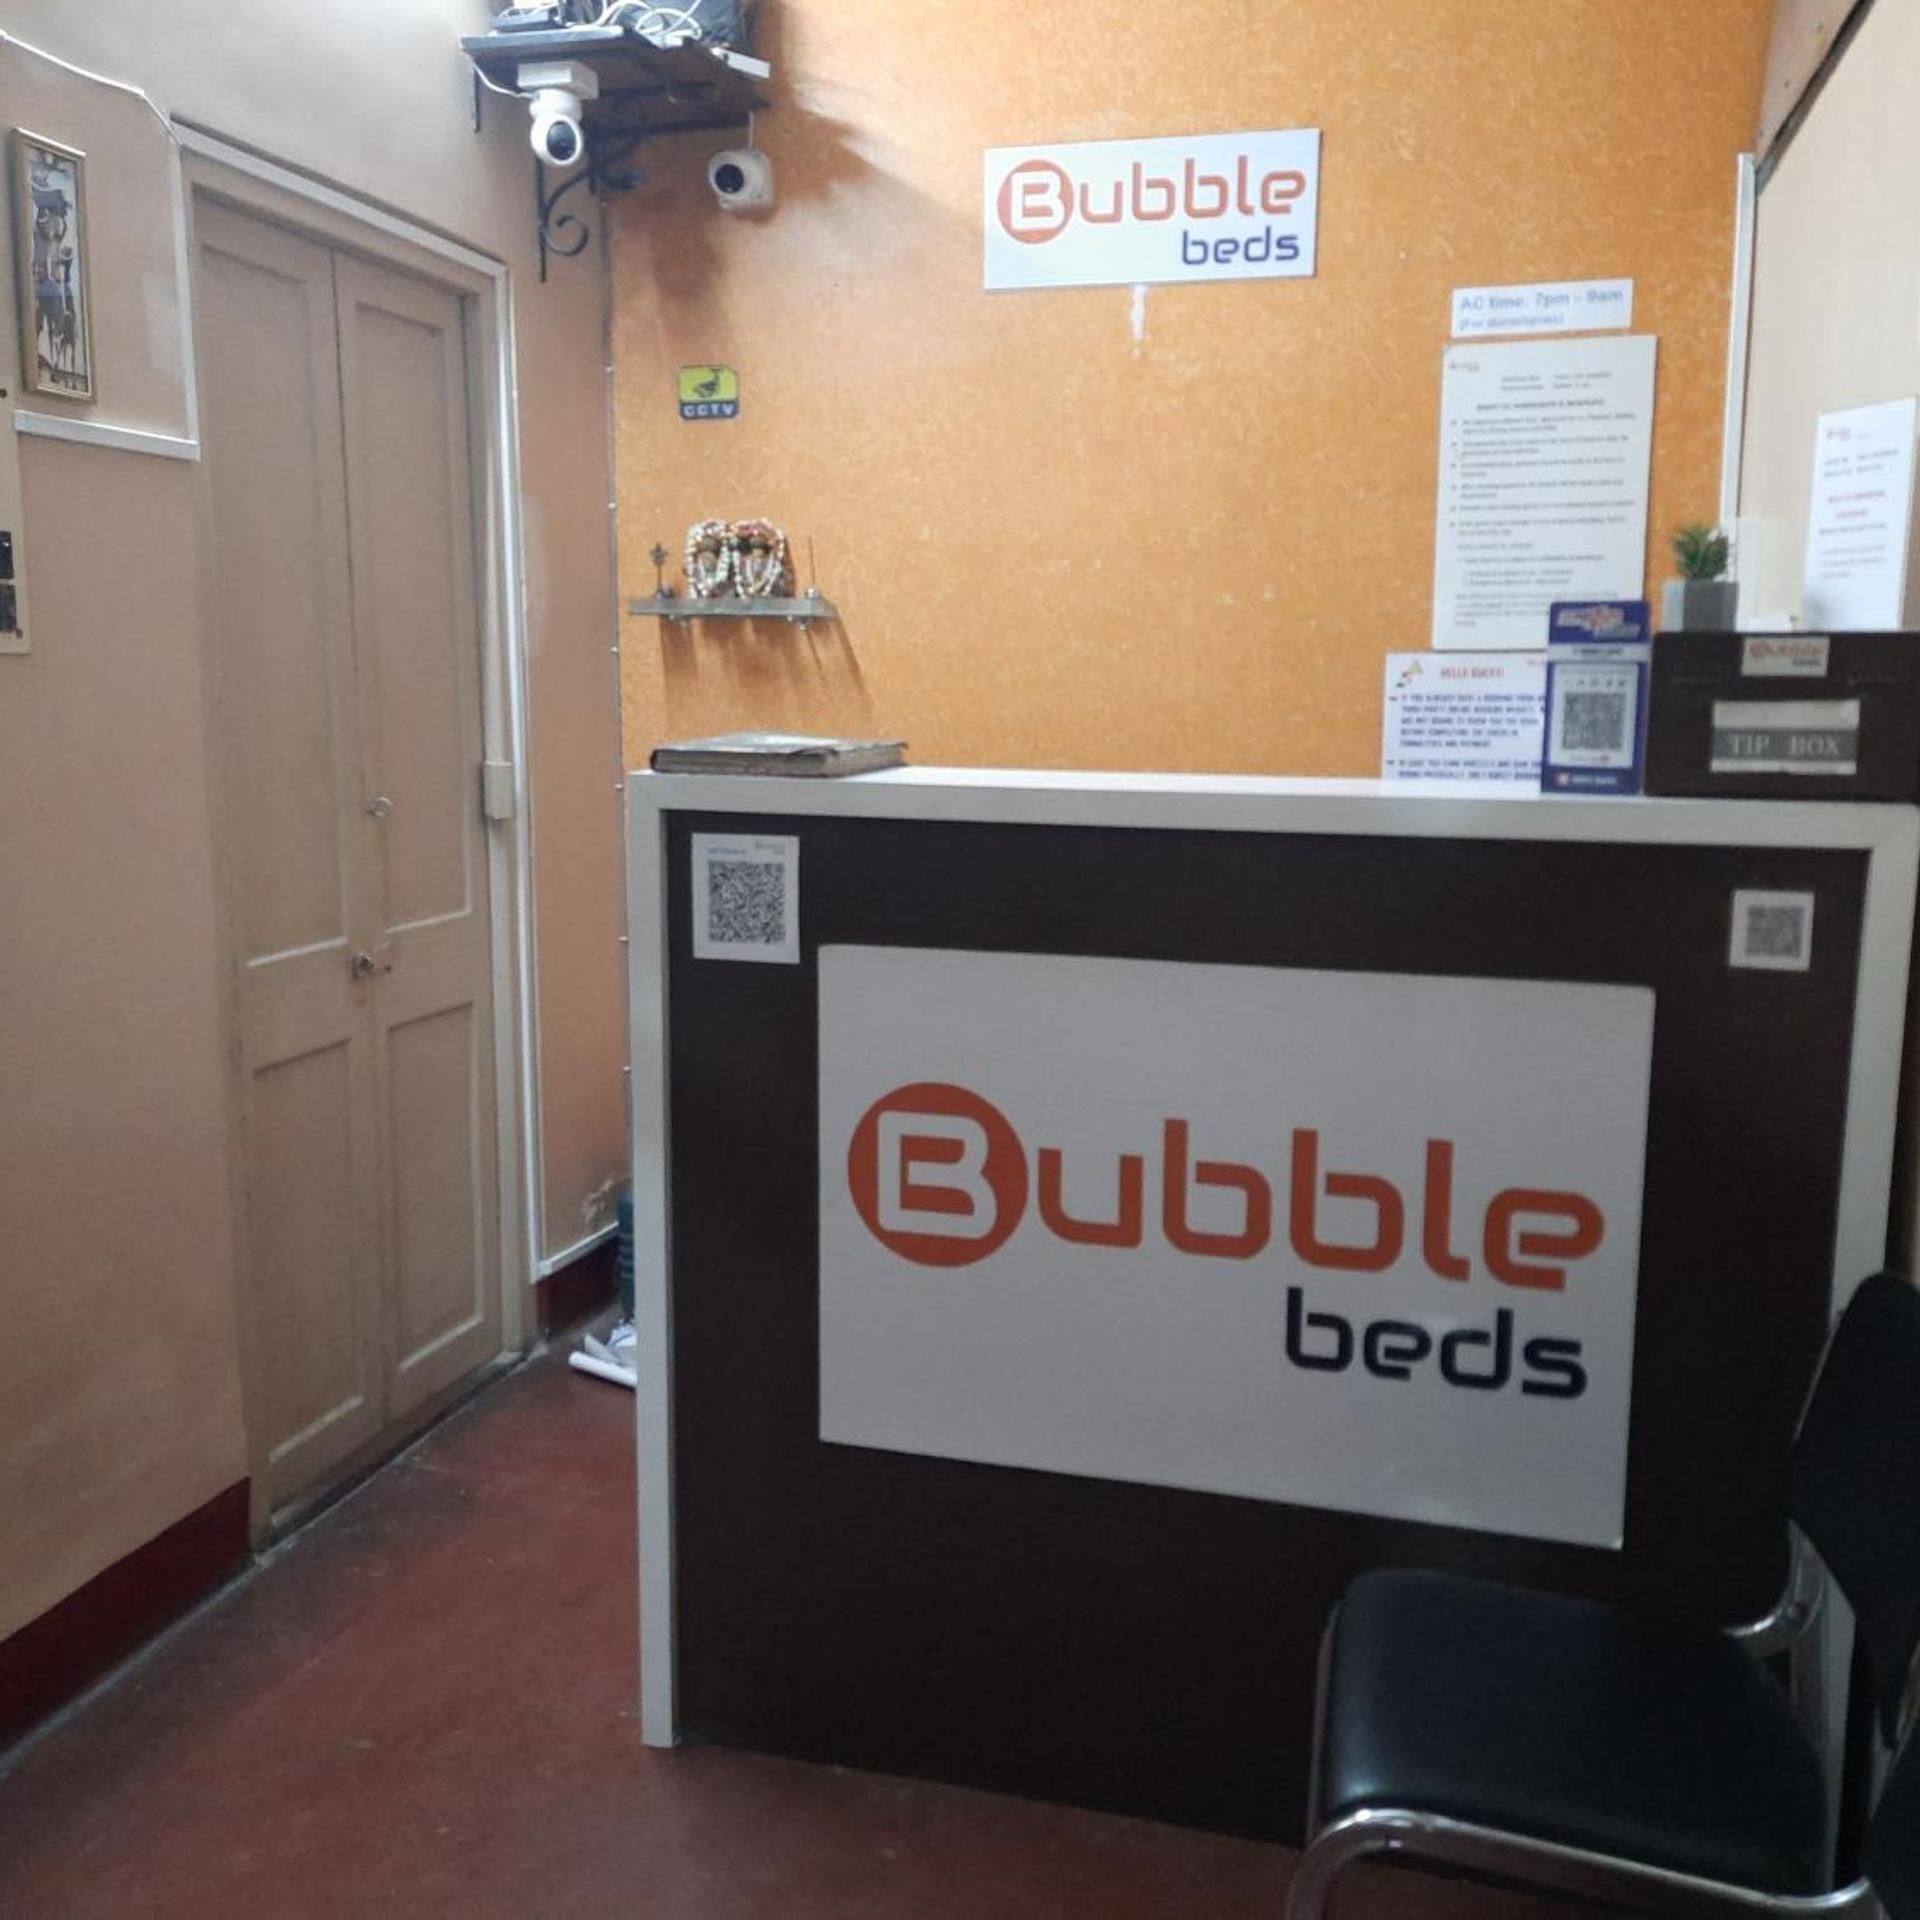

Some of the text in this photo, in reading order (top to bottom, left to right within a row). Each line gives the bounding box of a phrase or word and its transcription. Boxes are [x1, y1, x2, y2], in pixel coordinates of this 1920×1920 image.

[997, 155, 1306, 244] Bubble
[1182, 226, 1300, 265] beds
[683, 403, 735, 418] CCTV
[1729, 734, 1842, 756] TIP BOX
[847, 1082, 1606, 1291] Bubble
[1285, 1286, 1588, 1399] beds
